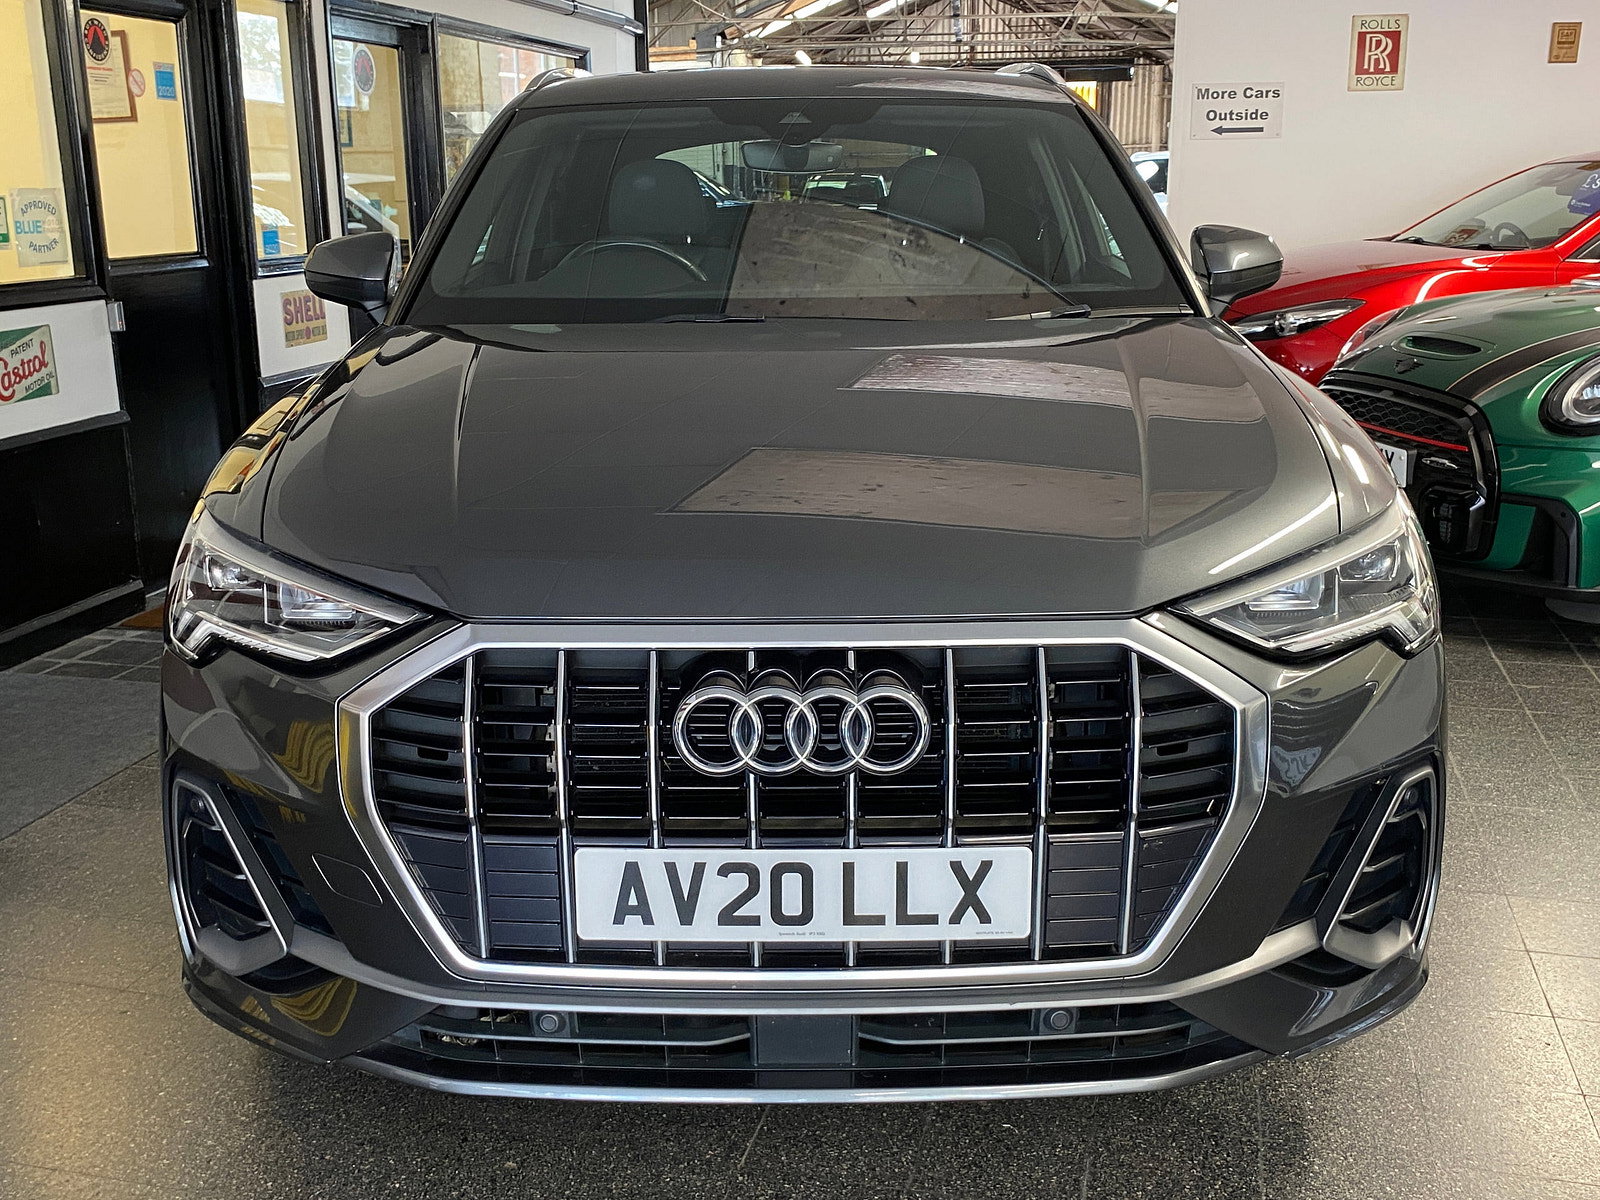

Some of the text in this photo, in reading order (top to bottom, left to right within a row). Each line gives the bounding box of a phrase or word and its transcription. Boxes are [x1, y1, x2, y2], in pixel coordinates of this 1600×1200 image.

[1360, 19, 1401, 30] ROLLS
[1355, 75, 1396, 87] ROYCE
[1196, 86, 1281, 100] More Cars
[1205, 108, 1269, 121] Outside
[20, 200, 57, 216] APPROVED
[14, 220, 43, 235] BLUE
[29, 238, 59, 253] PARTNER
[282, 295, 326, 326] SHELL
[10, 338, 34, 358] PATENT
[0, 340, 49, 401] Castrol
[24, 371, 54, 393] MOTOR OIL
[612, 859, 994, 927] AV20 LLX
